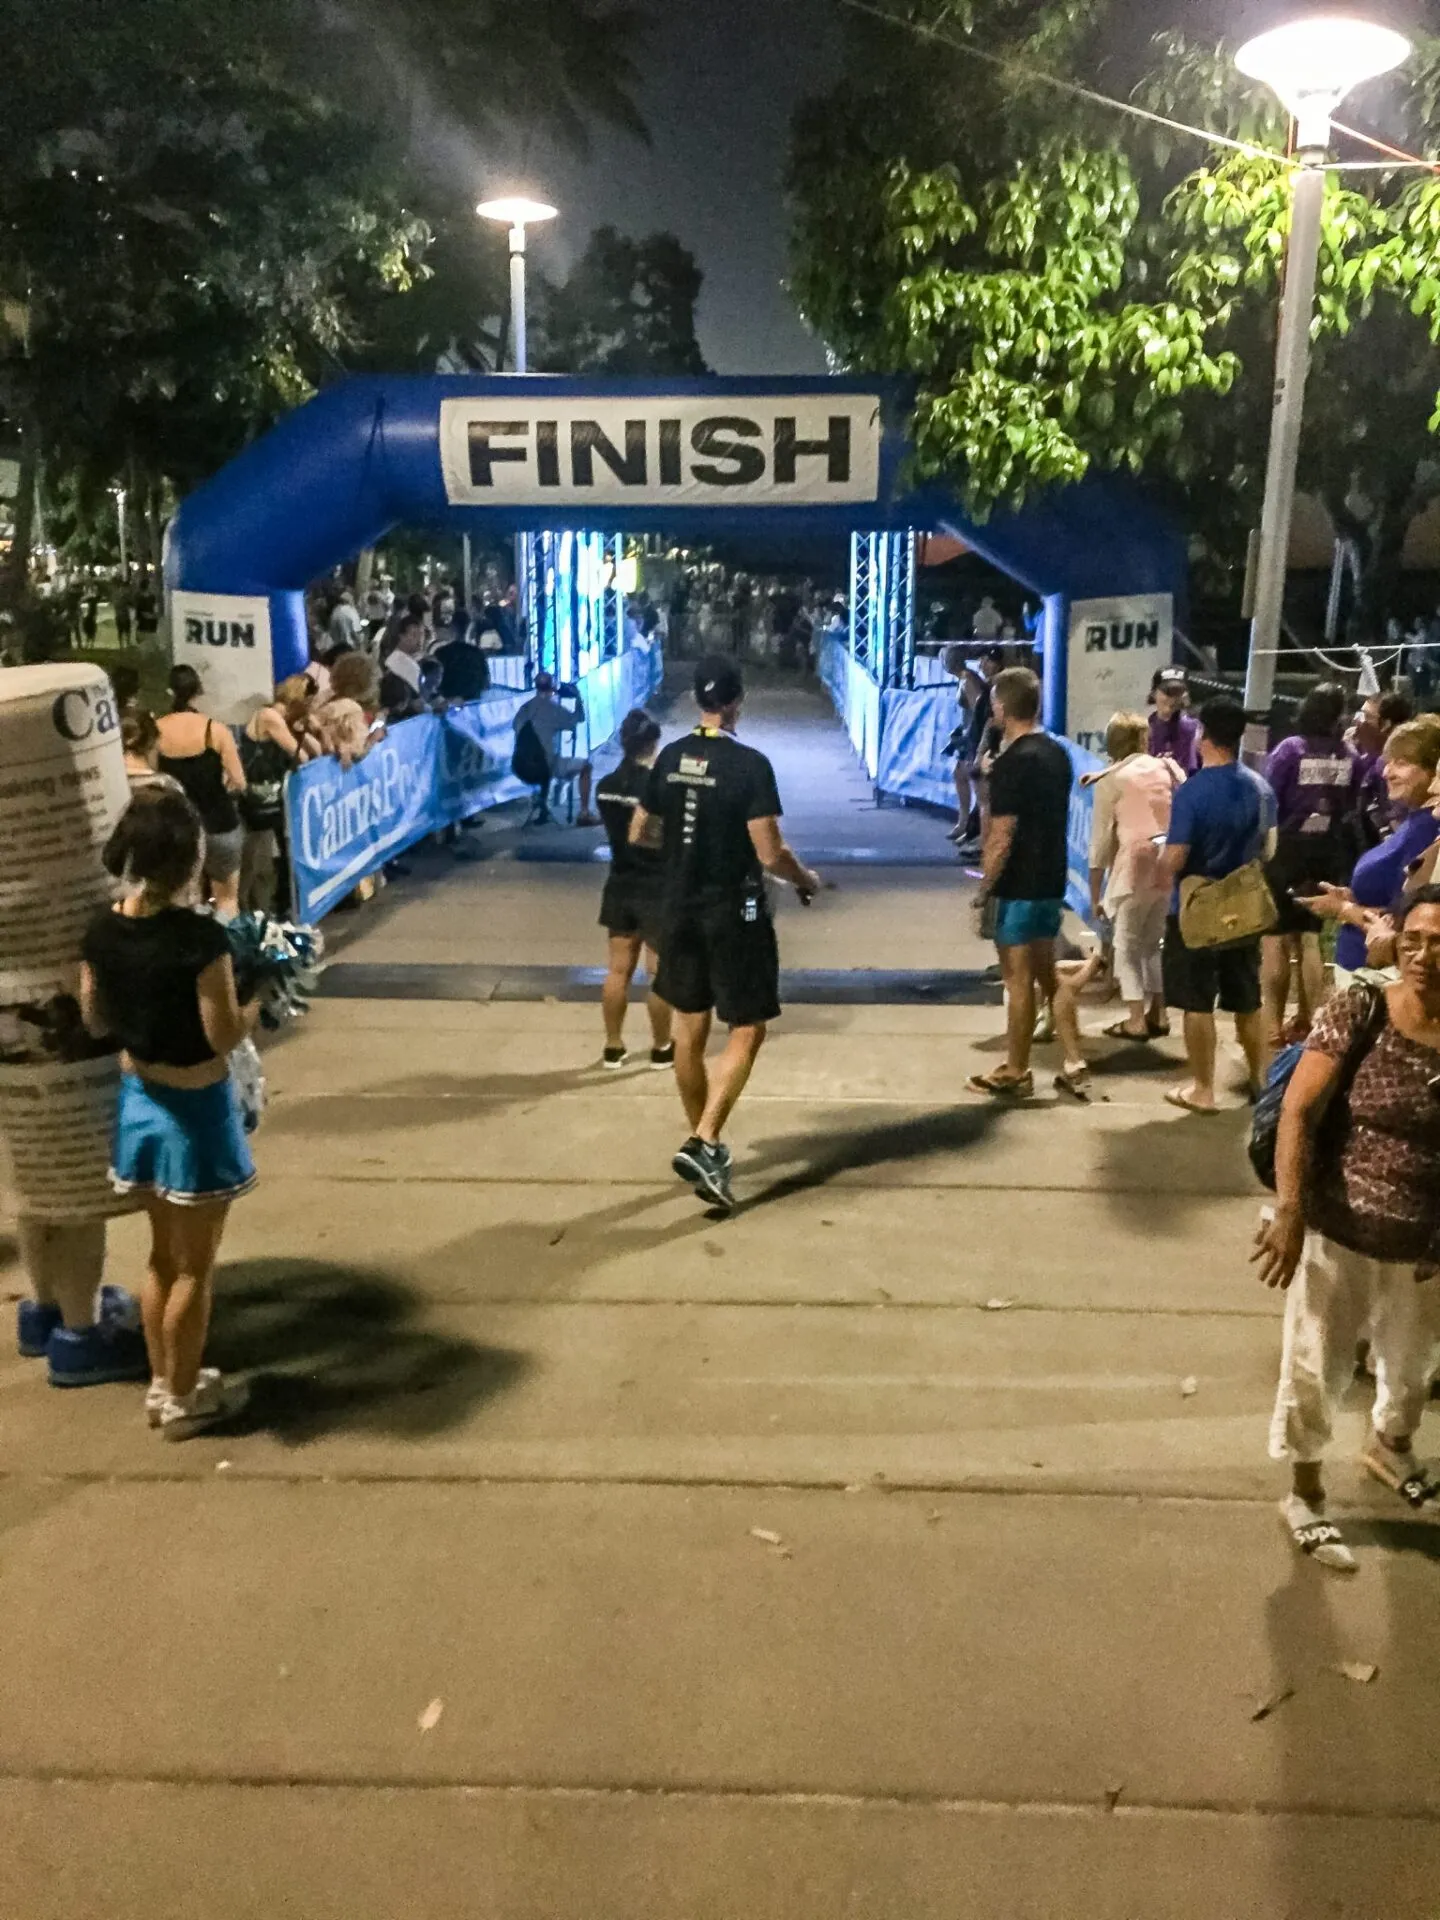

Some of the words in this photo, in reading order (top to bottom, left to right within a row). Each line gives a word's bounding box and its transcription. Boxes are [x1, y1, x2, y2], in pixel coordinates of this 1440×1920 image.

[467, 416, 851, 487] FINISH
[184, 617, 256, 648] RUN
[1085, 620, 1159, 653] RUN
[302, 777, 382, 869] Cairns
